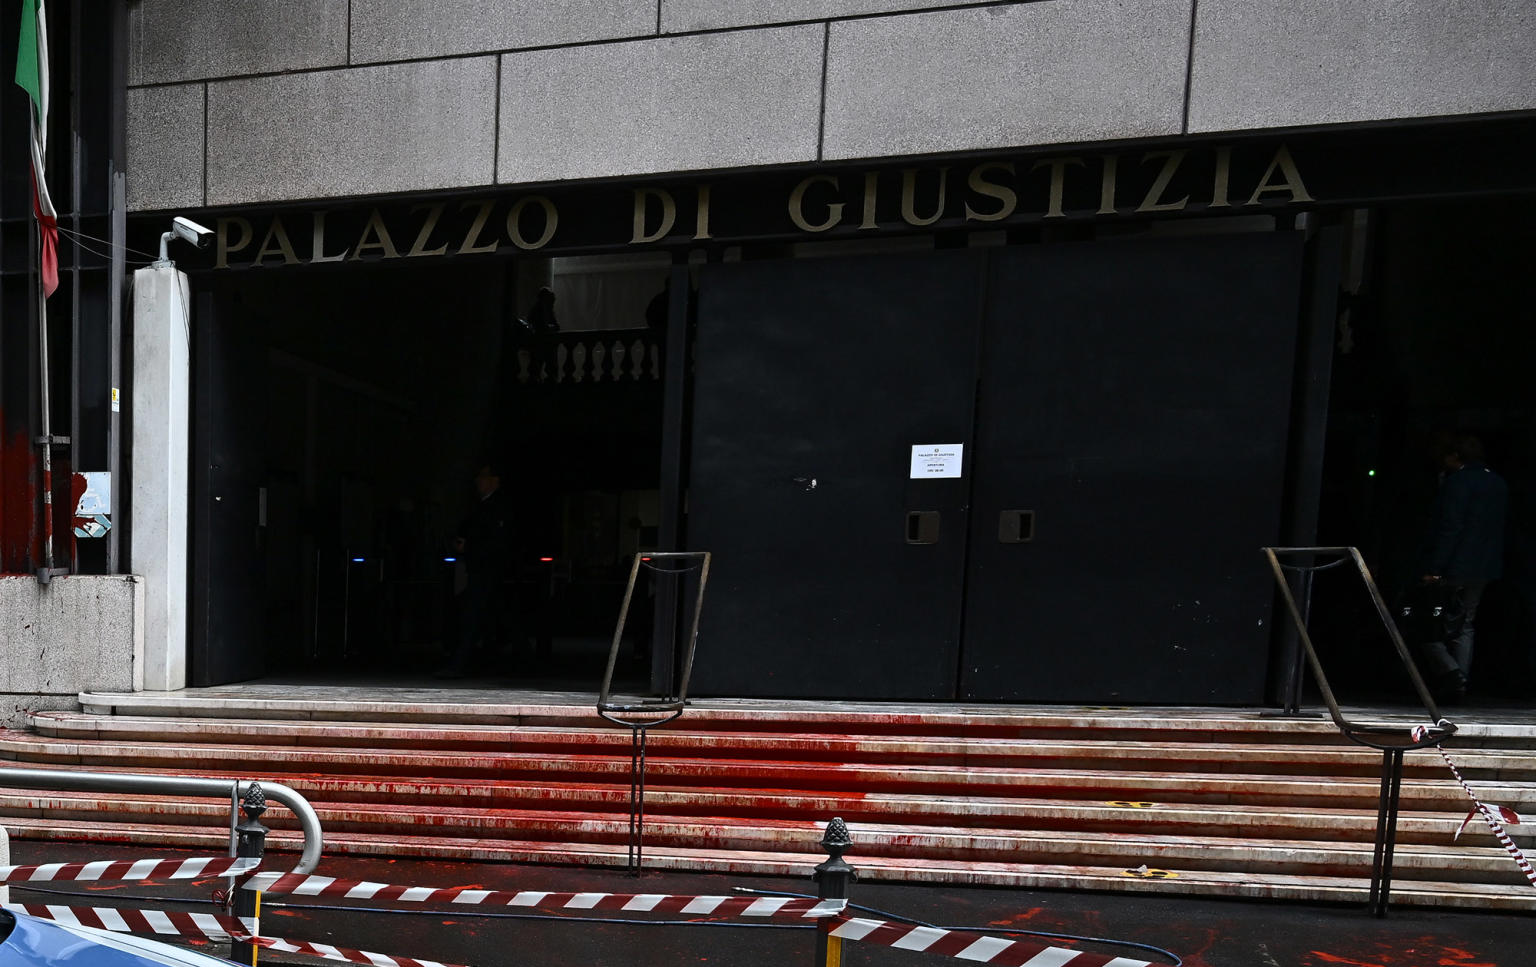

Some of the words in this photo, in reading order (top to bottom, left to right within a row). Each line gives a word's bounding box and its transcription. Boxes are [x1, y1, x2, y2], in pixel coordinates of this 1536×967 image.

[216, 195, 560, 269] PALAZZO
[629, 185, 714, 245] DI
[788, 143, 1317, 233] GIUSTIZIA
